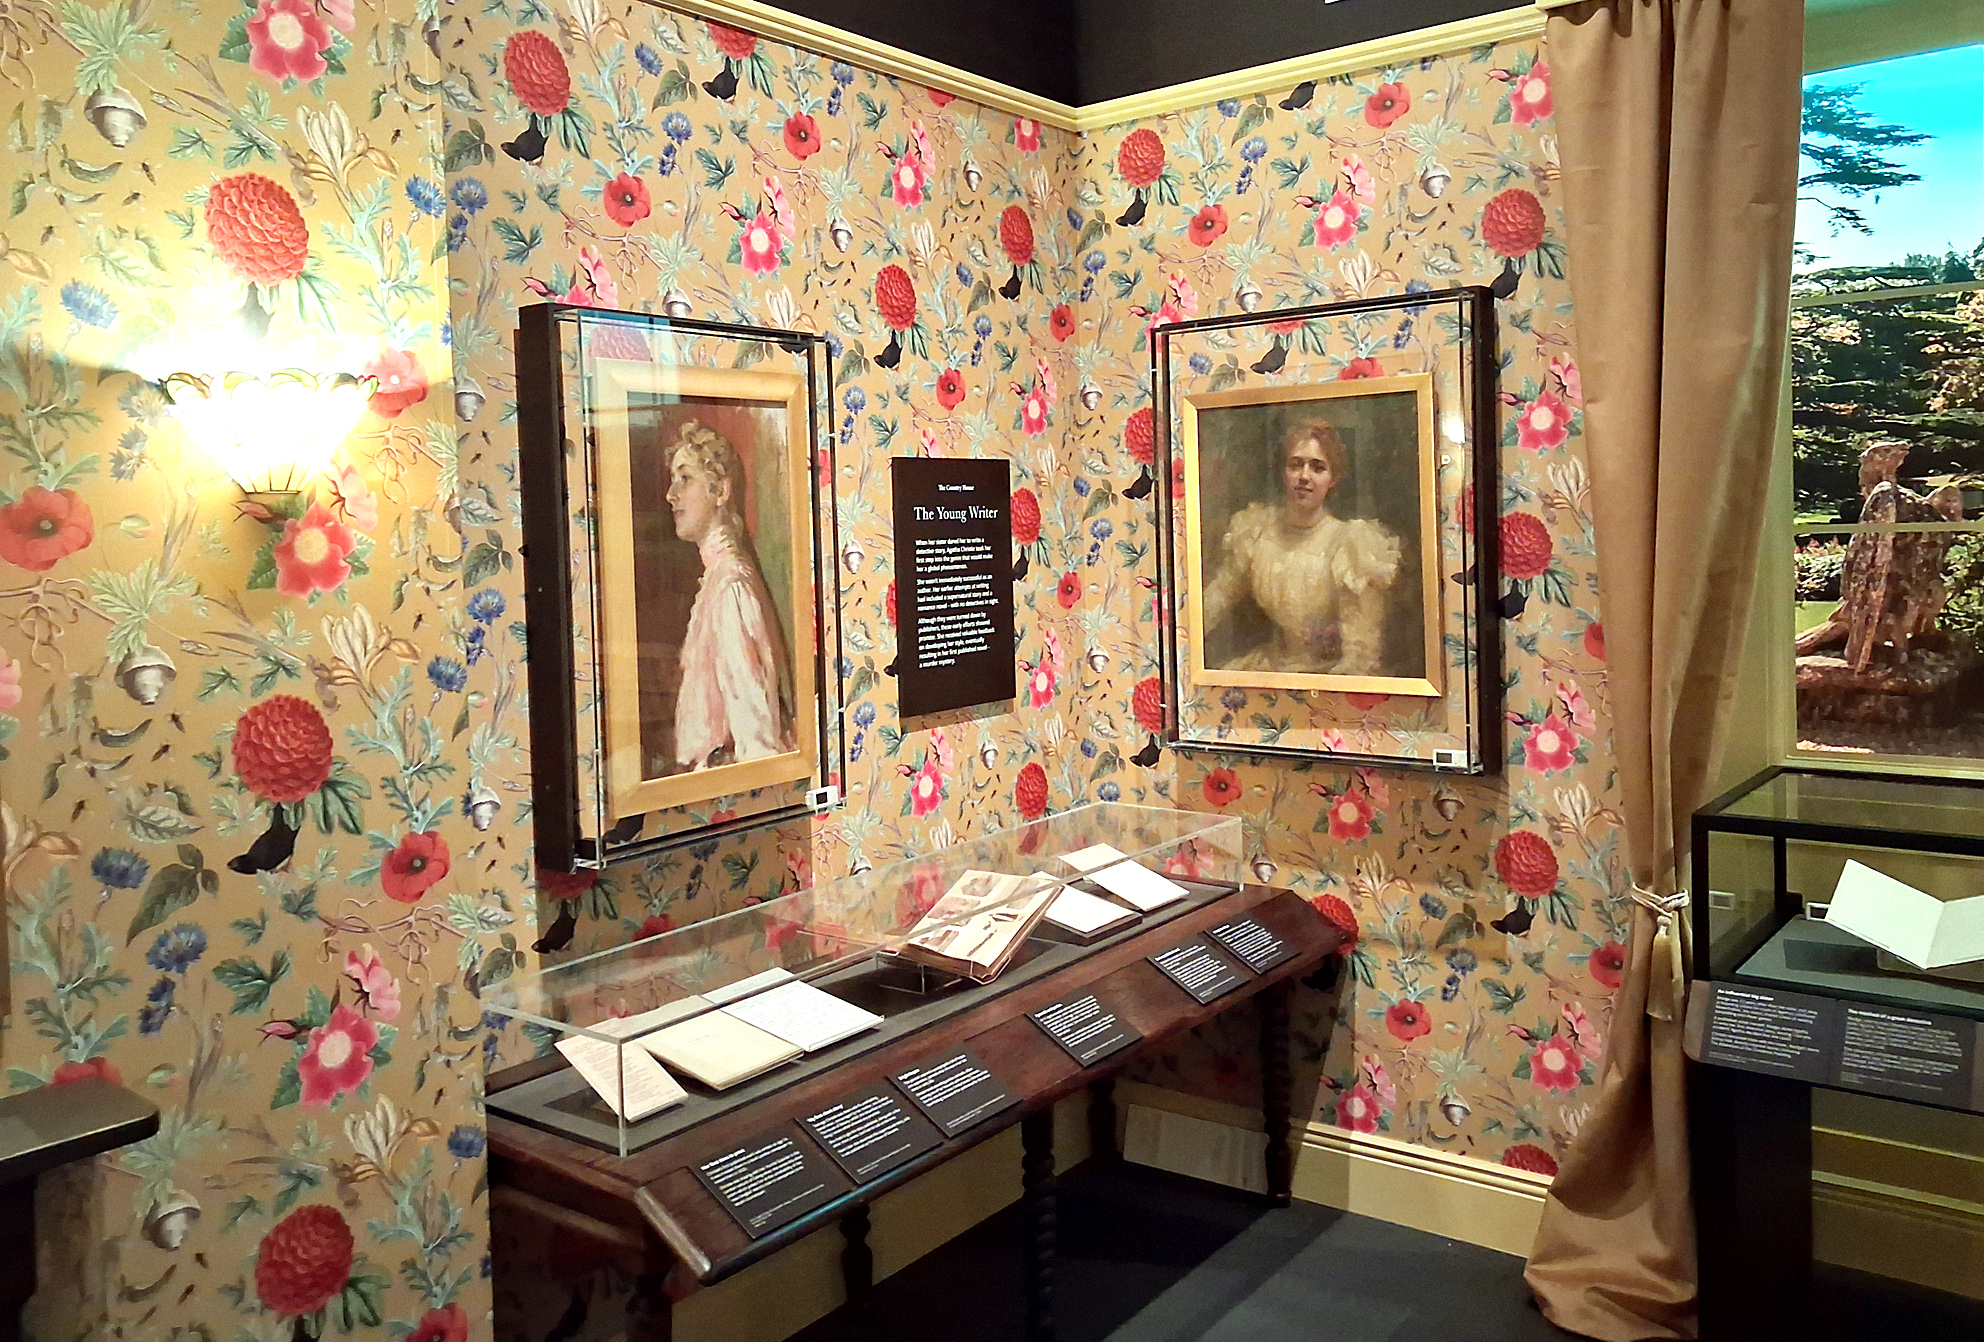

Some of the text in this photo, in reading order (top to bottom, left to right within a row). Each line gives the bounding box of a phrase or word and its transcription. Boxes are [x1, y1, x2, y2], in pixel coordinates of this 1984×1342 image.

[914, 506, 998, 523] The Young Writer
[958, 646, 976, 655] published
